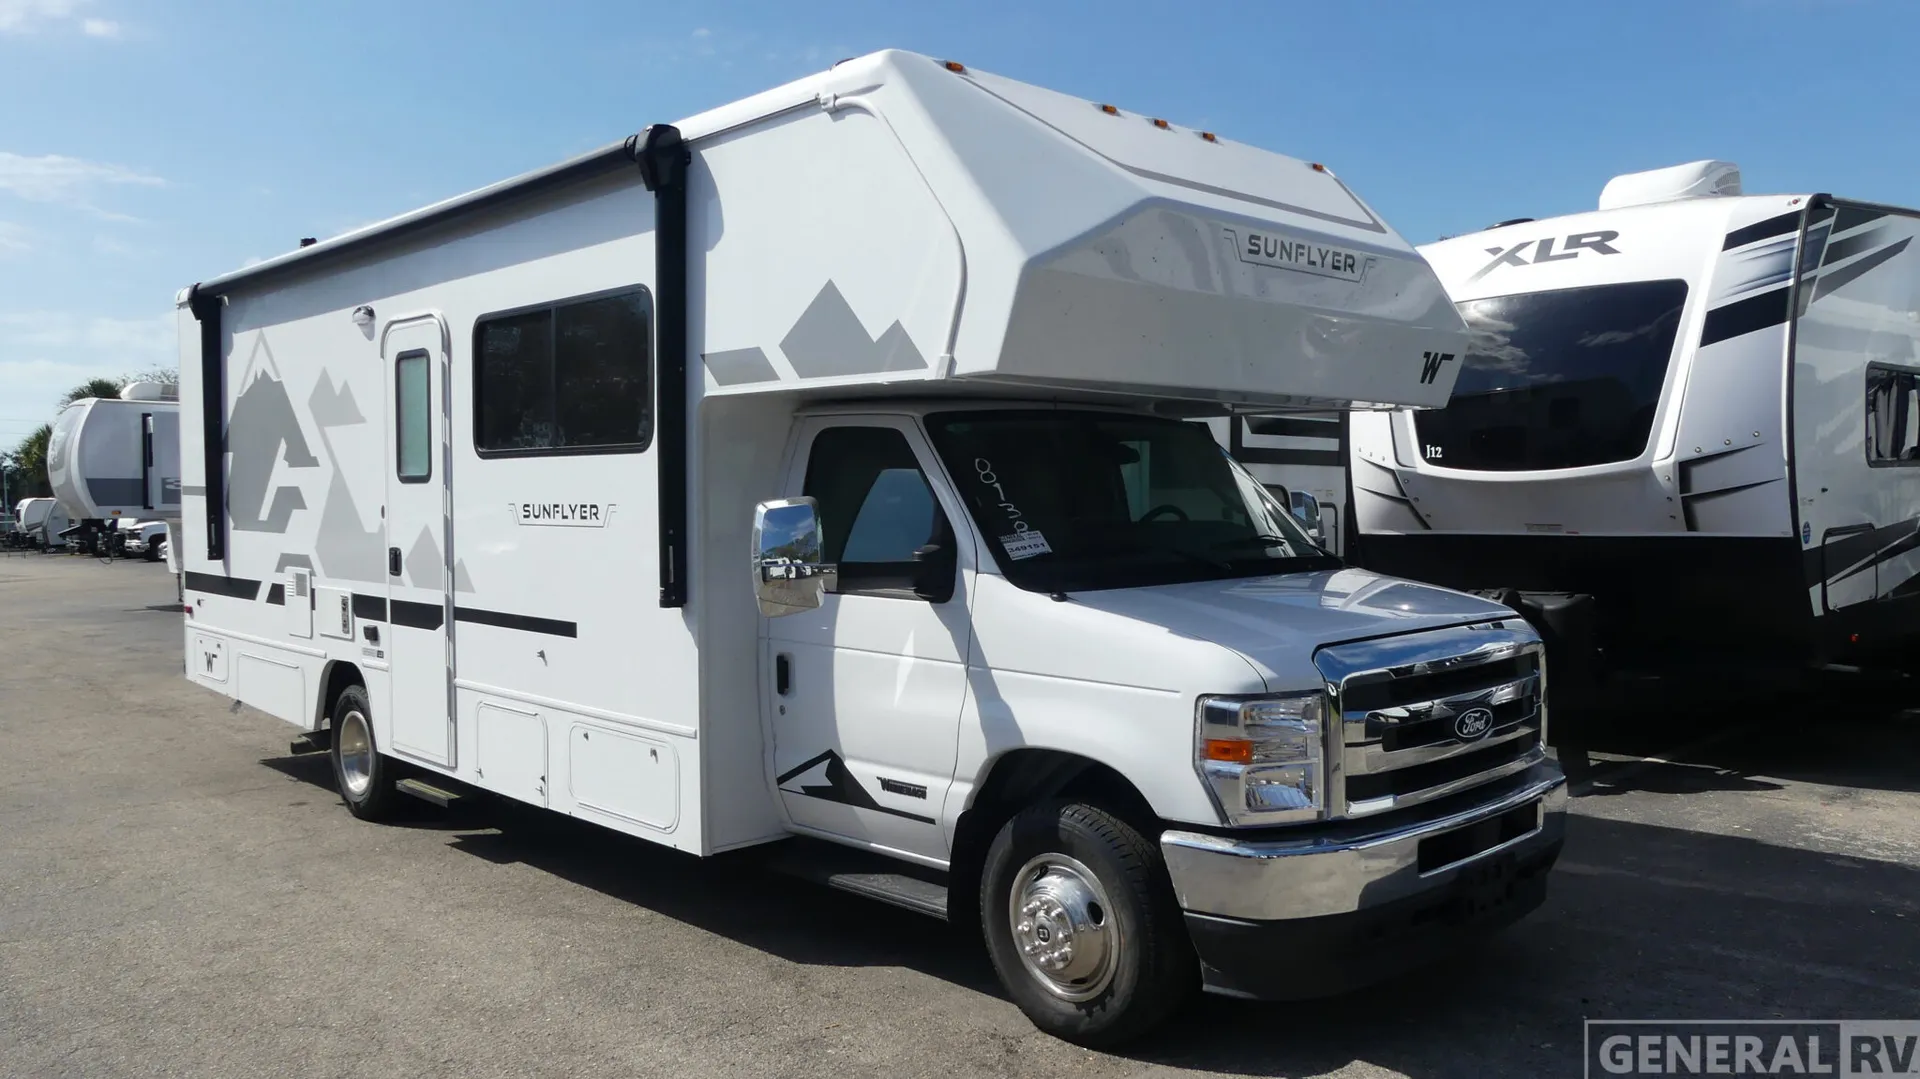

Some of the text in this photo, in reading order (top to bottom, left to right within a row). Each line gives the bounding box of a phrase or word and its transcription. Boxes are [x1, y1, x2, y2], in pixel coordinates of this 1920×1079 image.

[1248, 234, 1356, 274] SUNFLYER
[1466, 230, 1622, 284] XLR
[1426, 444, 1443, 459] J12
[522, 503, 600, 521] SUNFLYER
[1462, 712, 1488, 734] Ford
